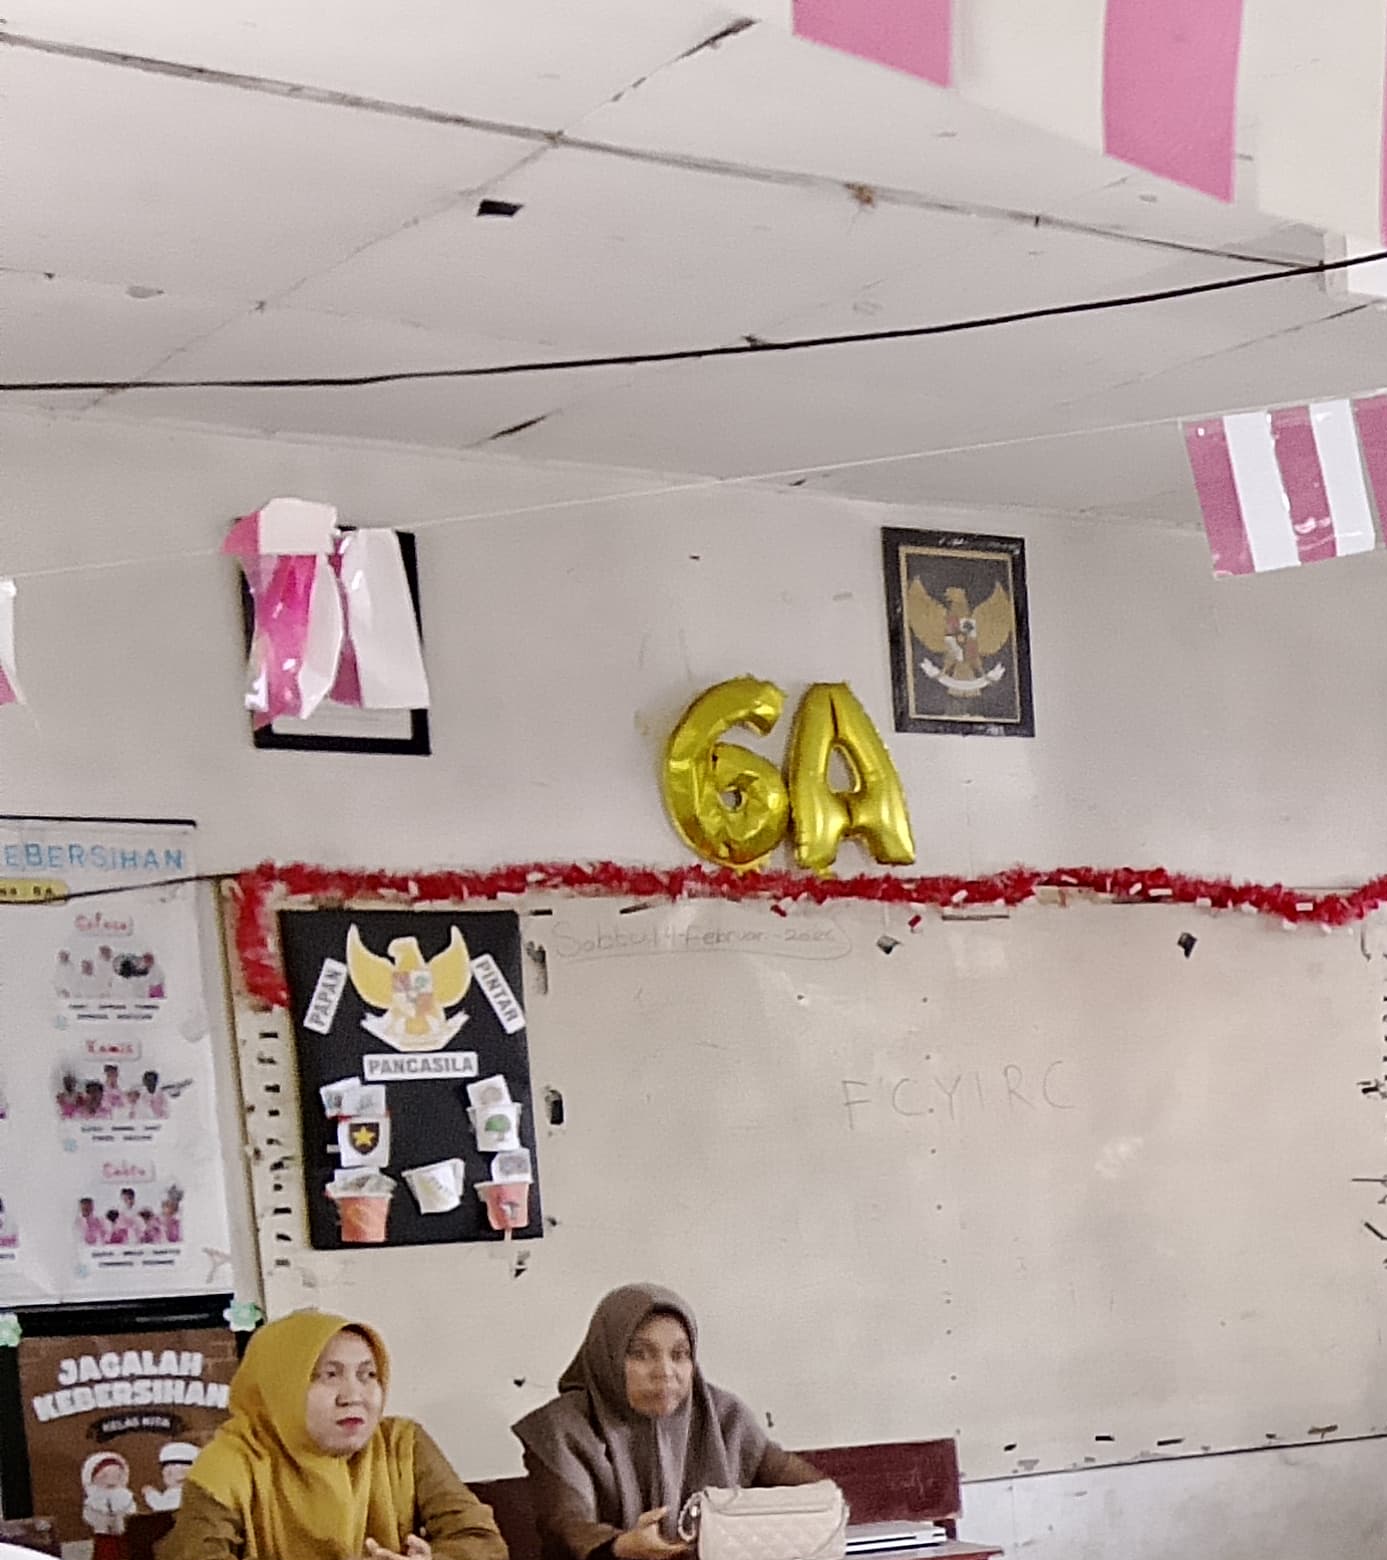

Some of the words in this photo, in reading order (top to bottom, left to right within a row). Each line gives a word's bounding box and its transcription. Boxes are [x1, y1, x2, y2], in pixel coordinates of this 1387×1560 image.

[663, 675, 916, 870] 6A
[310, 966, 343, 1027] PAPAN
[475, 961, 519, 1022] PINTAR
[368, 1056, 474, 1075] PANCASILA
[33, 1378, 230, 1422] KEBERSIHAN
